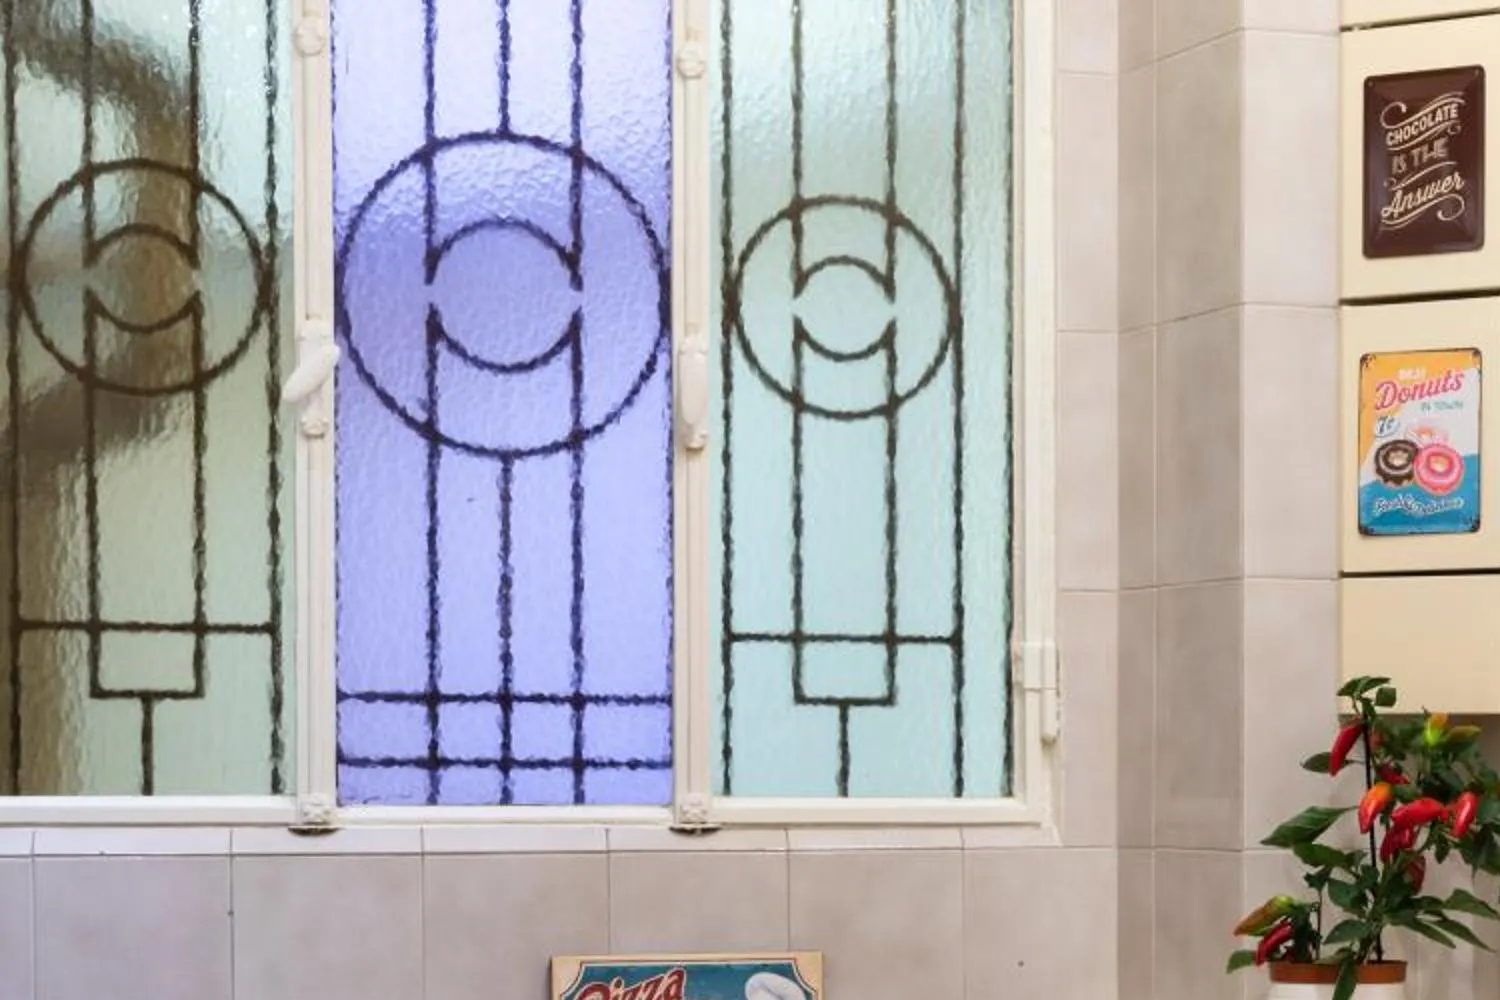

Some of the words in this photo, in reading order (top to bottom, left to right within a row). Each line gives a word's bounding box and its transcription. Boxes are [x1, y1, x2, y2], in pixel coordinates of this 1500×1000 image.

[1386, 102, 1459, 146] CHOCOLATE
[1392, 154, 1407, 174] IS
[1411, 137, 1449, 168] THE
[1381, 171, 1465, 218] Answer
[1375, 368, 1465, 411] Donuts
